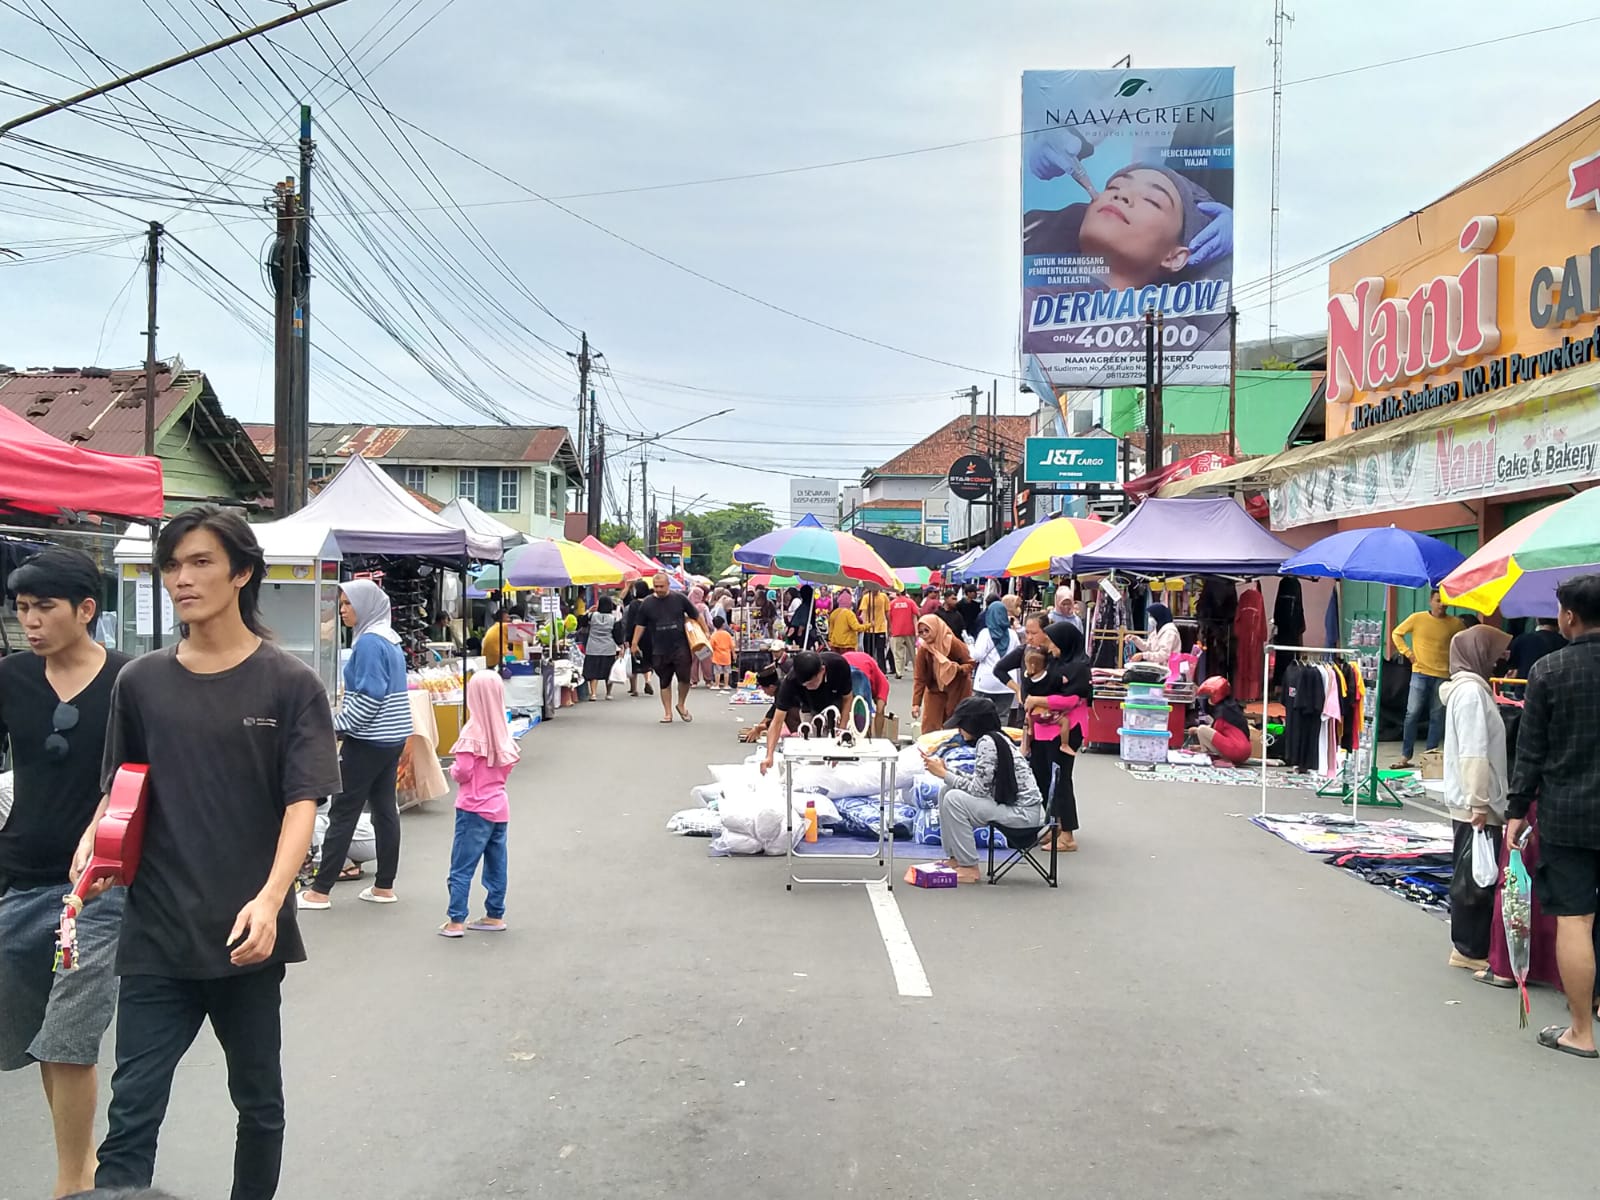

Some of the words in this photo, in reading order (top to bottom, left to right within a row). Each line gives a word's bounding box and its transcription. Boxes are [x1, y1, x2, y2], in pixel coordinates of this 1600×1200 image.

[1046, 106, 1215, 125] NAAVAGREEN
[1160, 148, 1211, 158] MENCERAHKAN
[1213, 147, 1232, 157] KULIT
[1184, 158, 1209, 167] WAJAH
[1033, 257, 1057, 266] UNTUK
[1057, 256, 1105, 266] MERANGSANG
[1028, 266, 1078, 276] PEMBENTUKAN
[1078, 266, 1110, 275] KOLAGEN
[1047, 276, 1062, 285] DAN
[1063, 276, 1090, 285] ELASTIN
[1032, 279, 1223, 328] DERMAGLOW
[1326, 215, 1496, 402] Nani
[1053, 333, 1075, 344] only
[1064, 355, 1127, 364] NAAVAGREEN
[1039, 449, 1085, 466] J&T
[1077, 458, 1104, 466] CARGO
[1435, 413, 1497, 494] Nani
[1497, 452, 1528, 481] Cake
[1531, 448, 1542, 474] &
[1545, 441, 1597, 473] Bakery
